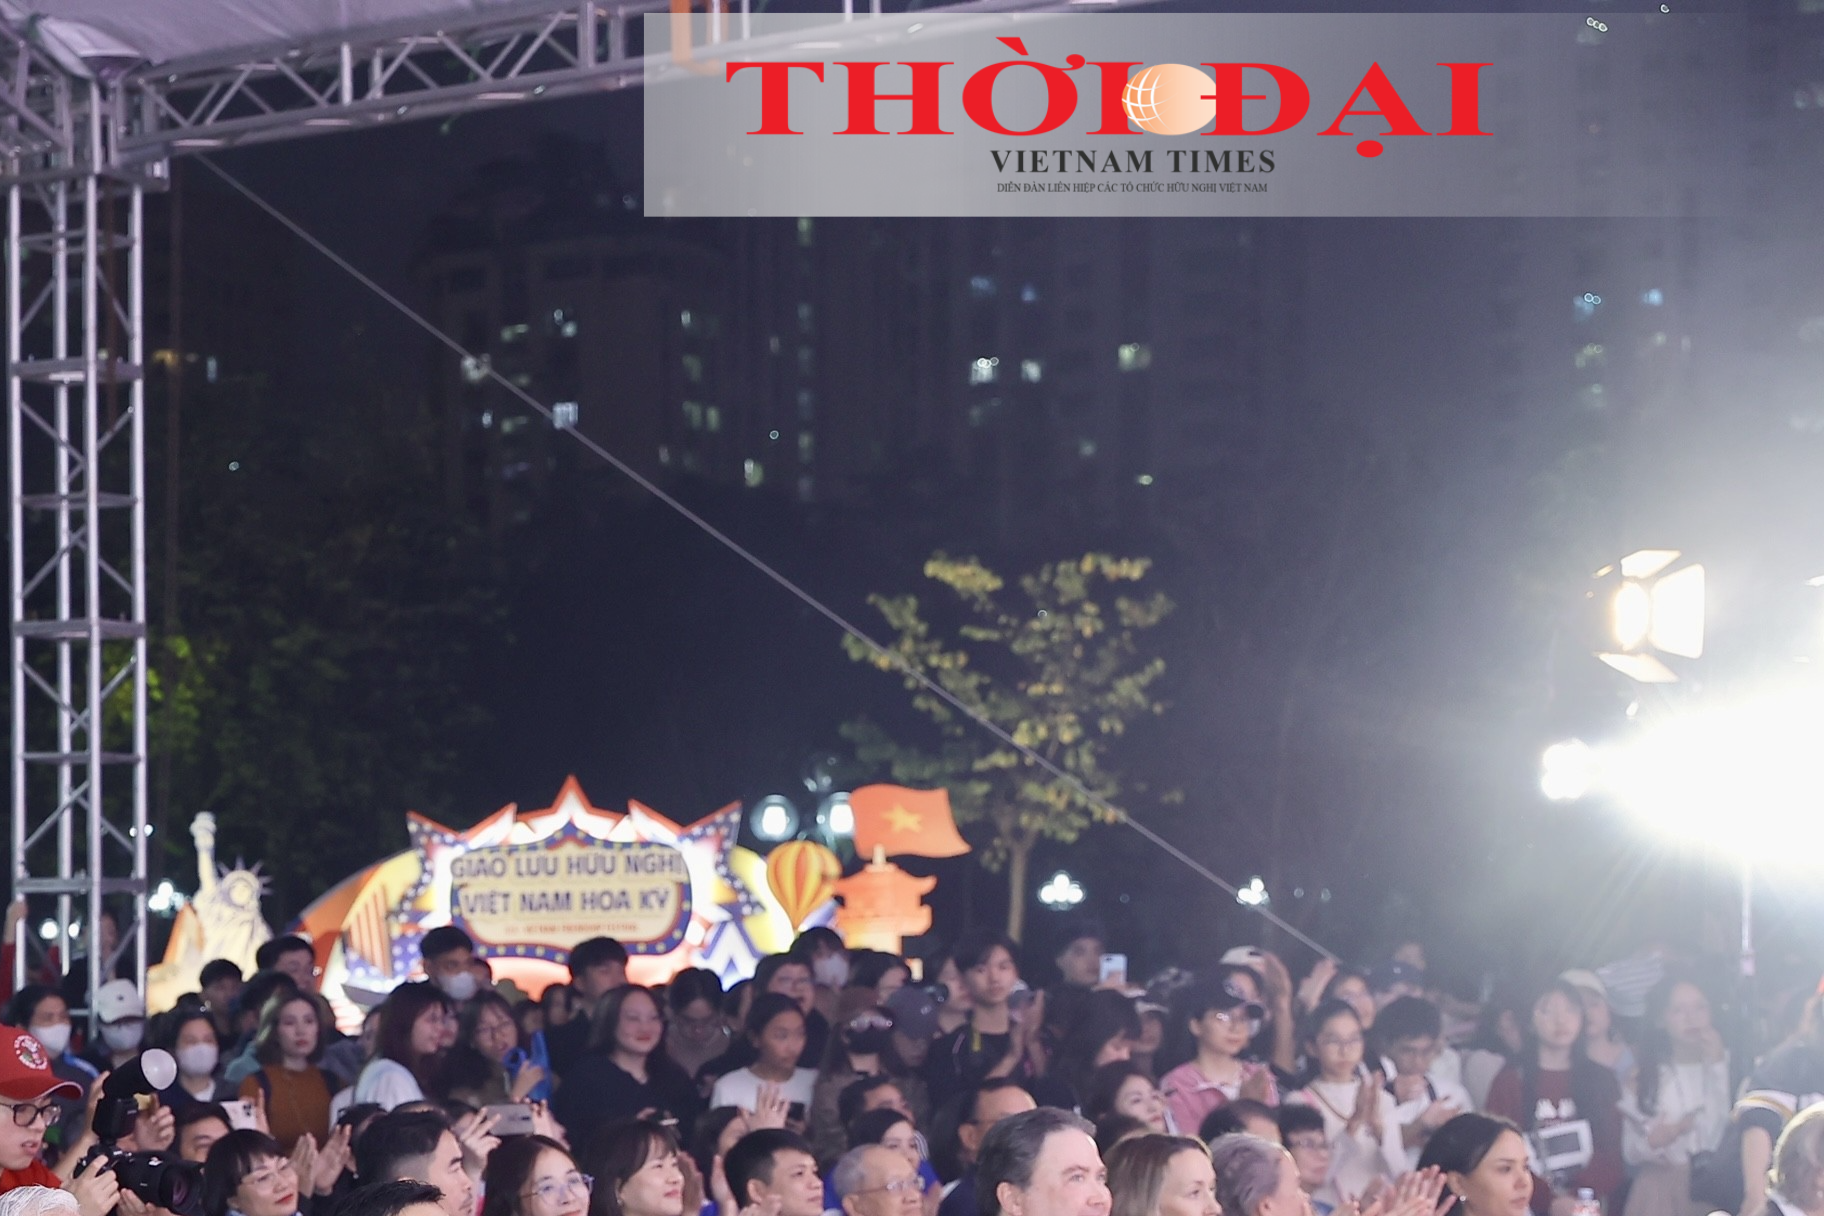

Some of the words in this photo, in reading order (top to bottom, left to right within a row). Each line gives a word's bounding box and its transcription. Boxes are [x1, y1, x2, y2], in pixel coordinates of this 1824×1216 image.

[450, 857, 507, 878] GIAO
[464, 889, 511, 914] VIỆT
[519, 890, 572, 912] NAM
[580, 890, 631, 912] HOA
